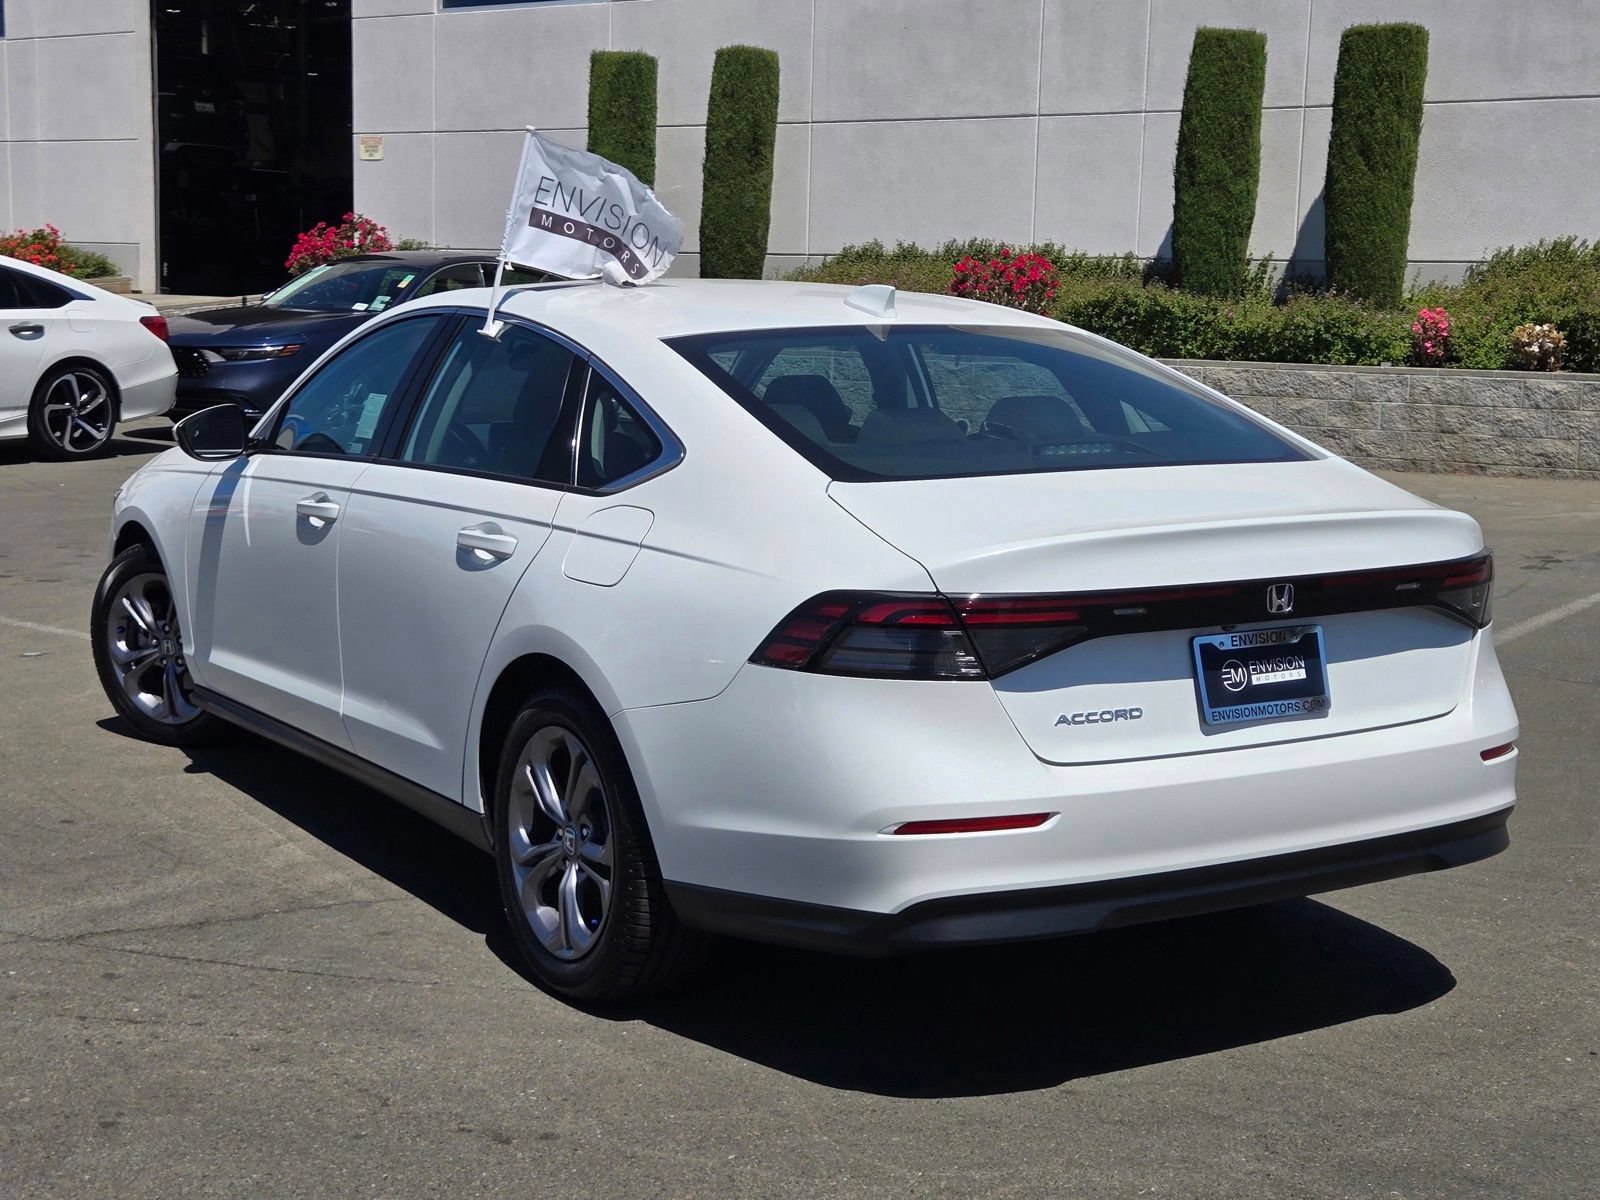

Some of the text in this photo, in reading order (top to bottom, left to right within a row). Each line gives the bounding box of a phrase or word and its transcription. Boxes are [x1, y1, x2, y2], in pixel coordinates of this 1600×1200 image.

[534, 175, 668, 268] ENVISION
[541, 214, 640, 274] MOTORS
[1230, 631, 1287, 647] ENVISION
[1249, 655, 1305, 674] ENVISION
[1255, 671, 1303, 682] MOTORS
[1054, 707, 1143, 727] ACCORD
[1212, 699, 1326, 722] ENVISIONMOTORS.COM
